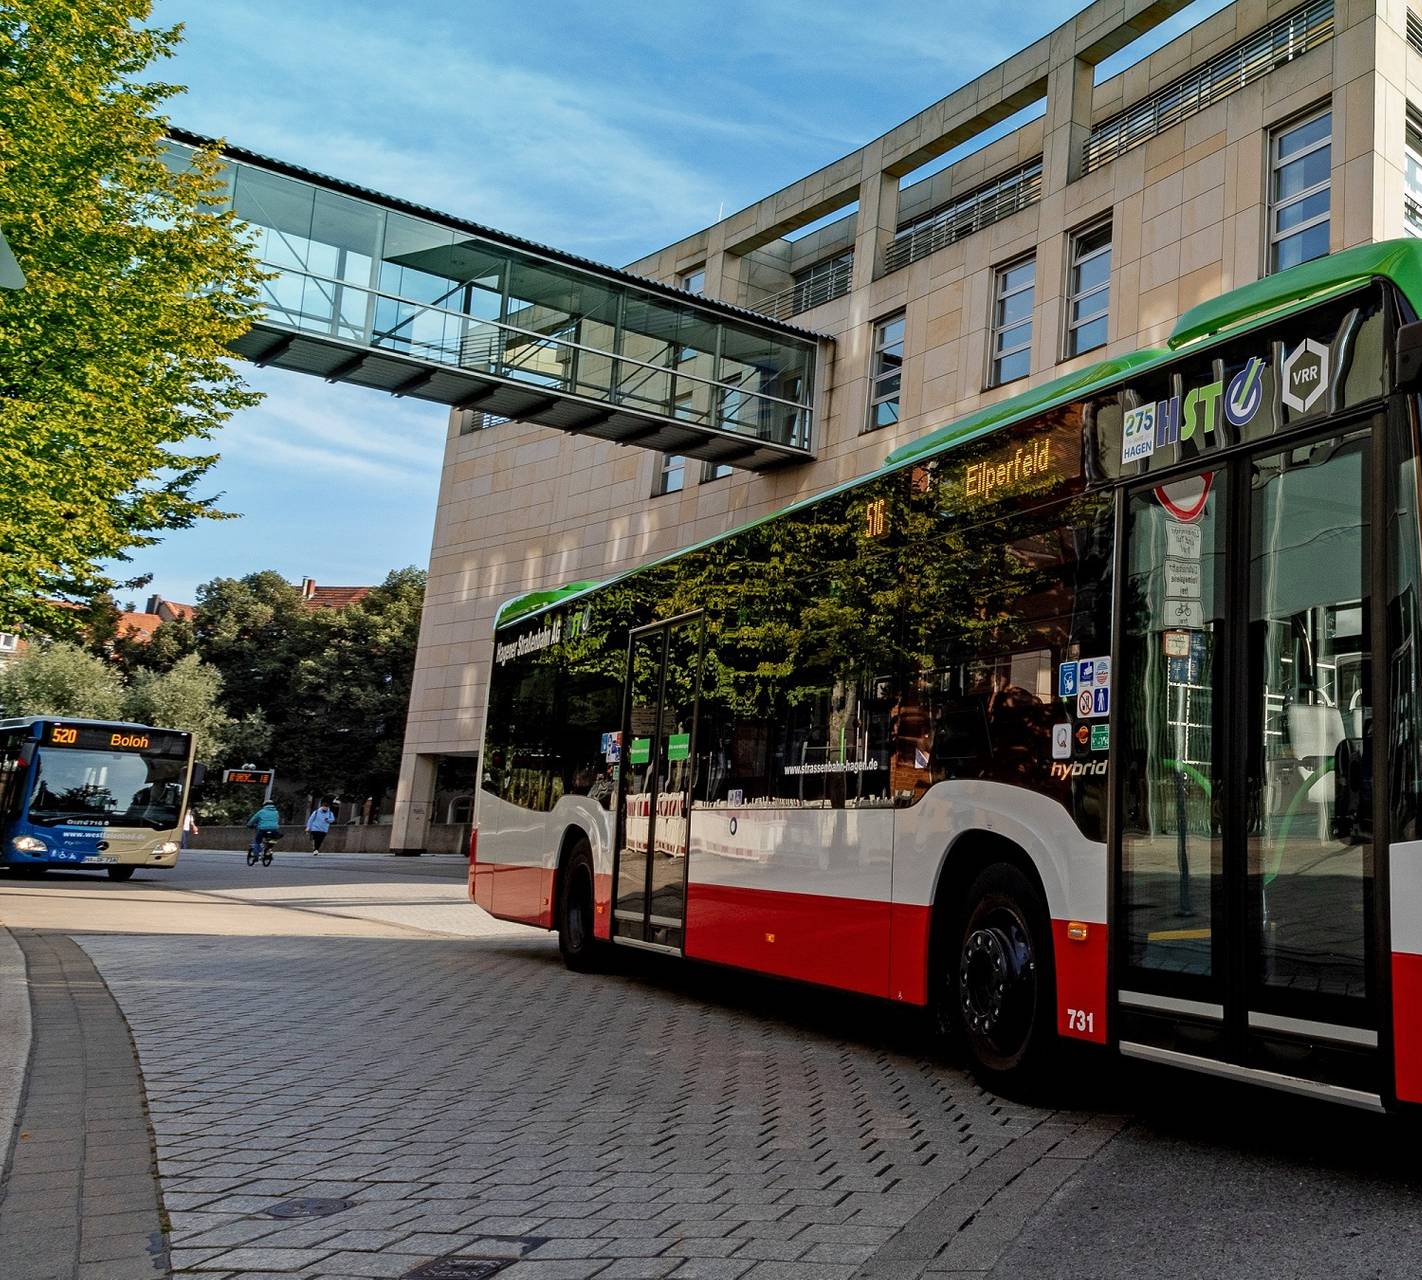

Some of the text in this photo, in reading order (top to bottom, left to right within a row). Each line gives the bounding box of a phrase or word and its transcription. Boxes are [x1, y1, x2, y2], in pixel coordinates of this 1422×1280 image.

[1291, 364, 1319, 386] VRR
[1125, 407, 1153, 437] 275
[1155, 379, 1224, 449] HST
[1123, 440, 1152, 459] HAGEN
[965, 438, 1050, 499] Eilperfeld
[864, 498, 885, 538] 516
[495, 641, 518, 667] Hagener
[51, 728, 78, 744] 520
[110, 733, 149, 748] Boloh
[784, 758, 878, 775] www.strassenbahn-hagen.de
[1050, 760, 1108, 780] hybrid
[1066, 1008, 1094, 1033] 731
